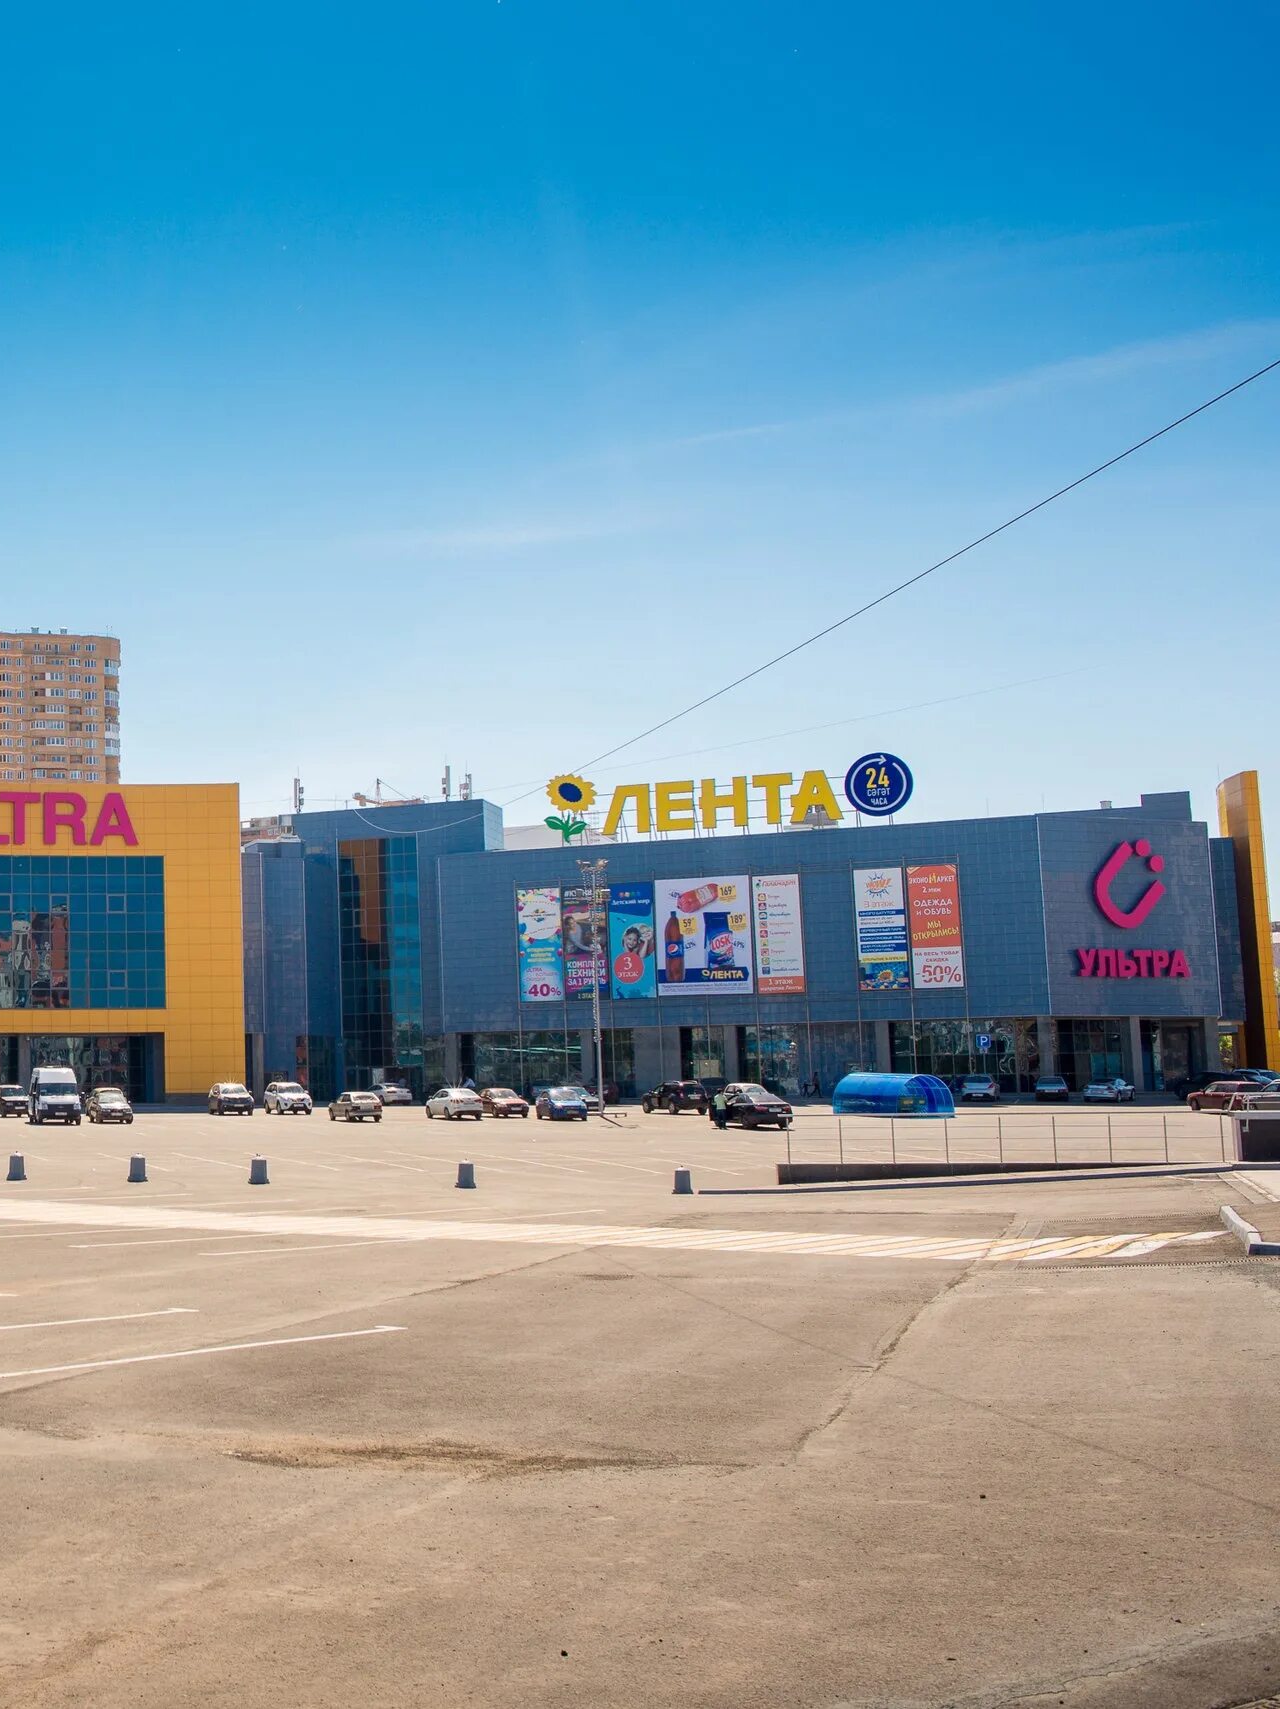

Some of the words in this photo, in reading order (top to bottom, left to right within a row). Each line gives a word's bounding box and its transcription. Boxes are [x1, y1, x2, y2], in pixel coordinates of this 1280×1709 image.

[865, 767, 890, 788] 24
[602, 769, 844, 836] ЛЕНТА
[871, 797, 888, 806] ЧАСА
[720, 886, 732, 896] 169
[913, 898, 953, 907] ОДЕЖДА
[924, 907, 952, 916] ОБУВЬ
[683, 918, 691, 927] 59
[730, 914, 742, 924] 189
[927, 920, 941, 929] МЫ
[912, 926, 960, 941] ОТКРЫЛИСЬ!
[711, 935, 730, 950] LOSK
[567, 960, 605, 969] КОМПЛКТ
[623, 957, 632, 971] 3
[1077, 948, 1191, 978] УЛЬТРА
[710, 970, 744, 980] ЛЕНТА
[915, 964, 962, 983] -50%
[523, 983, 562, 997] -40%
